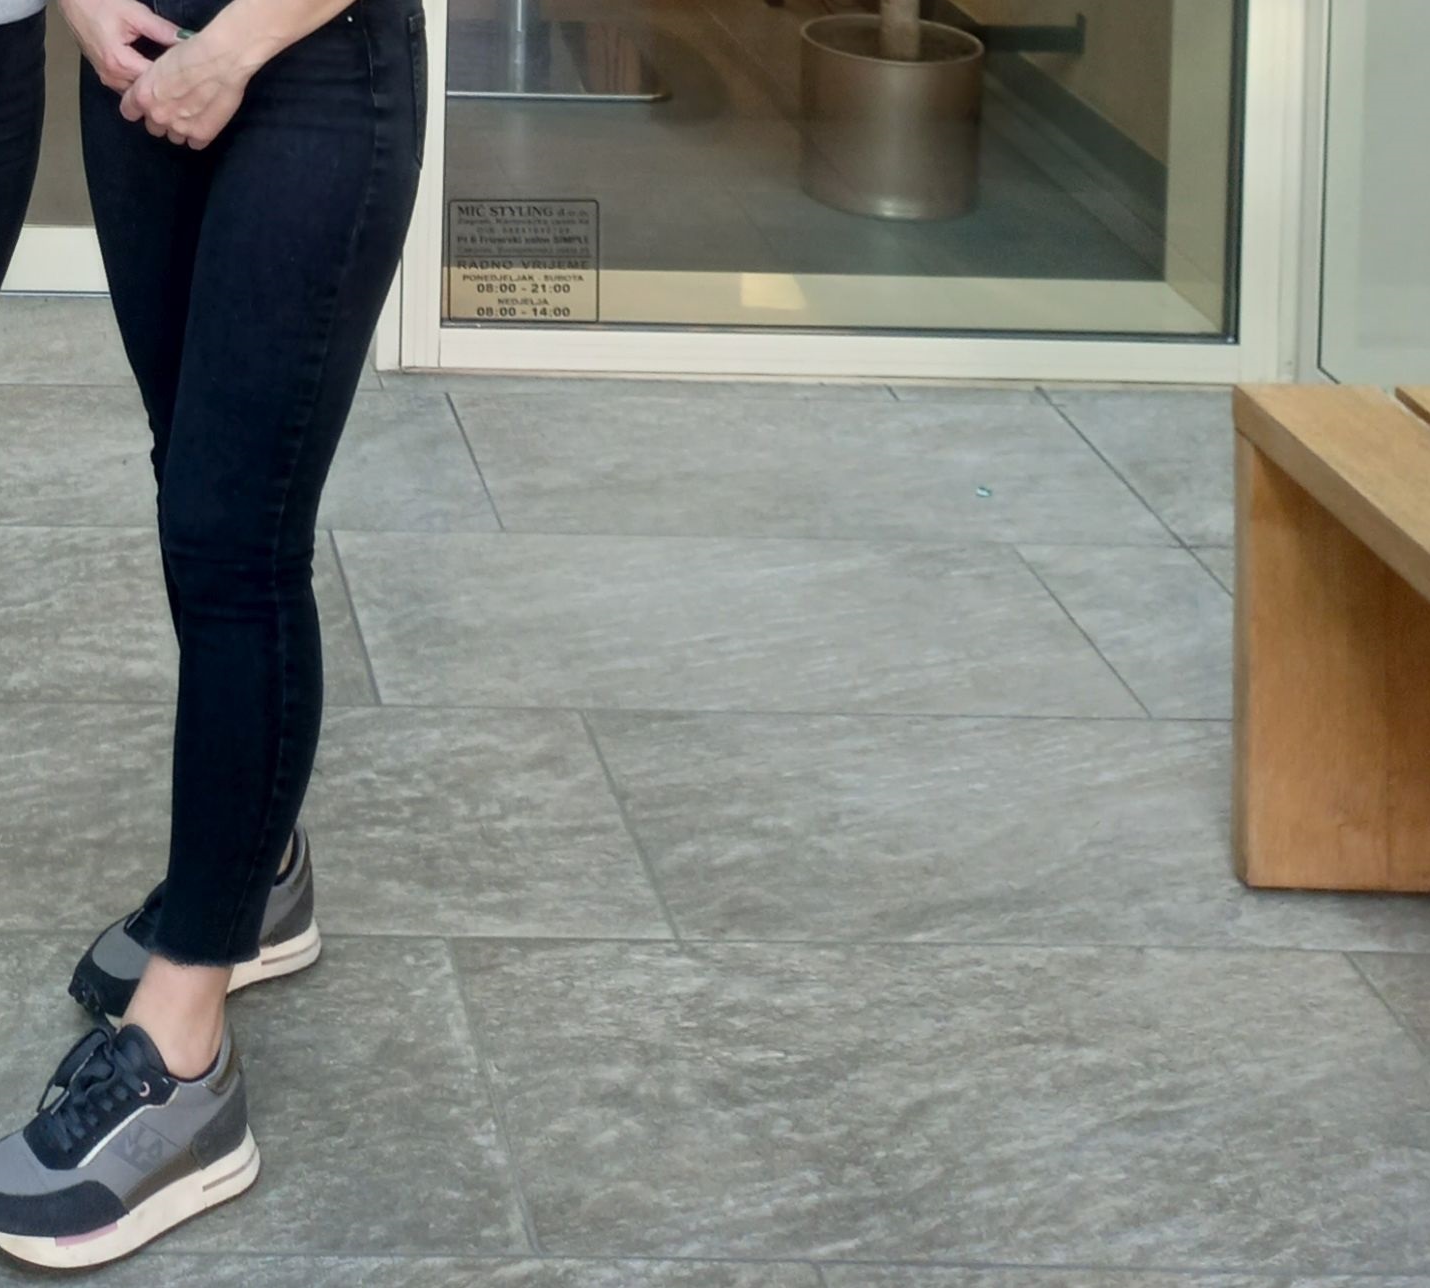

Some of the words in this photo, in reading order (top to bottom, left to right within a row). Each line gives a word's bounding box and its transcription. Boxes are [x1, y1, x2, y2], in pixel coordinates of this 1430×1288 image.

[489, 206, 554, 218] STYLING
[456, 259, 514, 270] RADNO
[476, 283, 517, 294] 08:00
[530, 283, 571, 294] 21:00
[476, 307, 517, 317] 08:00
[531, 307, 571, 317] 14:00
